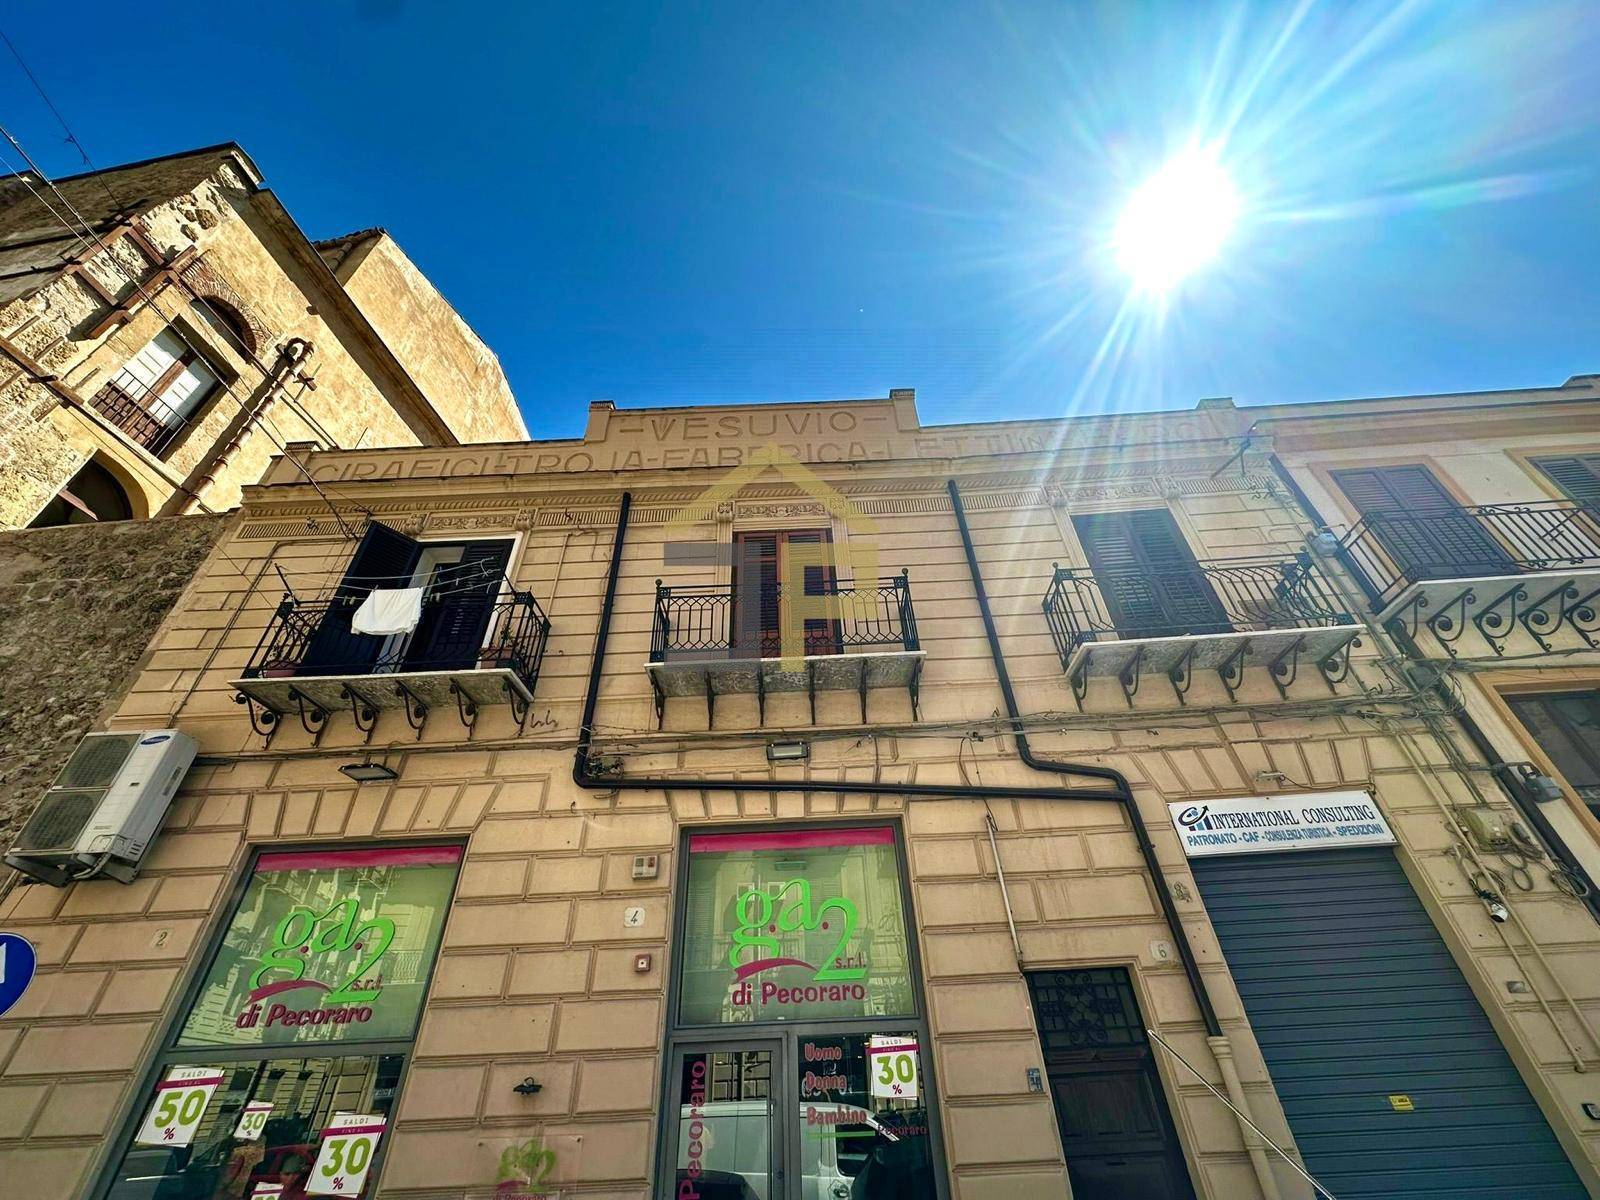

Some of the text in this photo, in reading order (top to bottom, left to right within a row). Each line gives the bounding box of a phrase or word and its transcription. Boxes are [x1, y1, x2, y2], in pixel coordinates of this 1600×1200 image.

[1211, 804, 1375, 830] INTERNATIONAL CONSULTING
[1186, 832, 1237, 846] PATRONATO
[1242, 831, 1260, 843] CAF
[1335, 823, 1384, 837] SPEDIZIONI
[630, 910, 639, 924] 4
[1158, 943, 1167, 958] 6
[732, 981, 866, 1006] di Pecoraro
[236, 1003, 373, 1029] di Pecoraro
[804, 1042, 842, 1061] Uomo
[805, 1070, 847, 1091] Donna
[877, 1054, 914, 1085] 30
[154, 1089, 207, 1128] 50
[806, 1105, 867, 1127] Bambino
[241, 1112, 266, 1130] 30
[343, 1117, 370, 1126] SALDI
[678, 1061, 706, 1200] Pecoraro
[321, 1137, 372, 1177] 30
